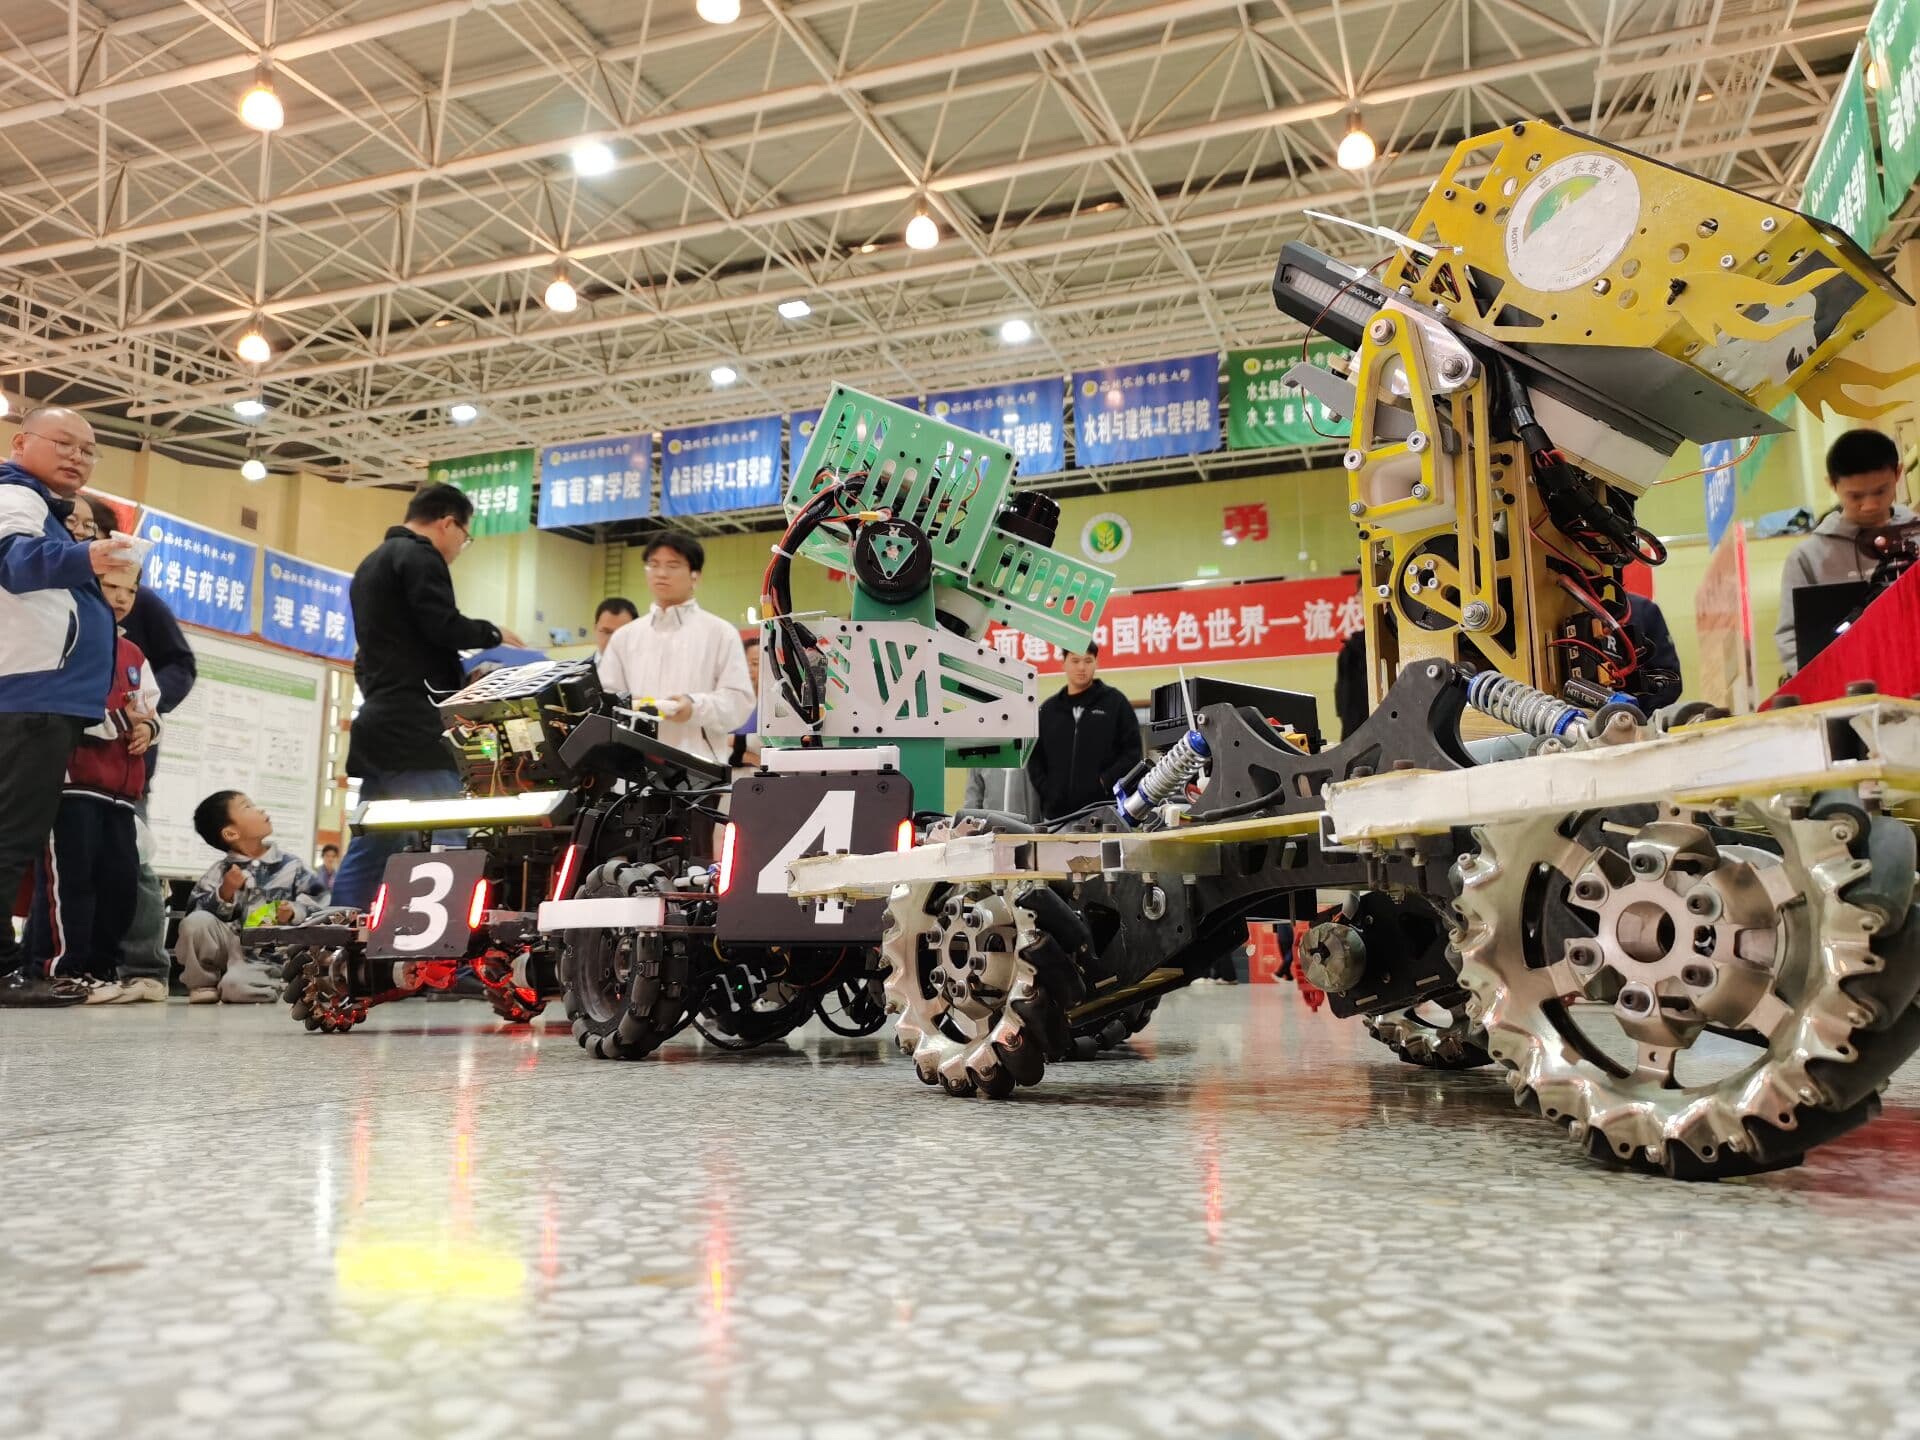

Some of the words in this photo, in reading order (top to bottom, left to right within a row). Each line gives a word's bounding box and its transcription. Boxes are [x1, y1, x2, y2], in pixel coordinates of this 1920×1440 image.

[1338, 280, 1385, 307] RBOMAST
[1083, 397, 1211, 448] 水利与建筑工程学院
[550, 470, 641, 509] 葡萄酒学院
[149, 554, 245, 612] 化学与药学院
[272, 594, 346, 642] 理学院
[757, 790, 856, 925] 4
[393, 861, 455, 951] 3
